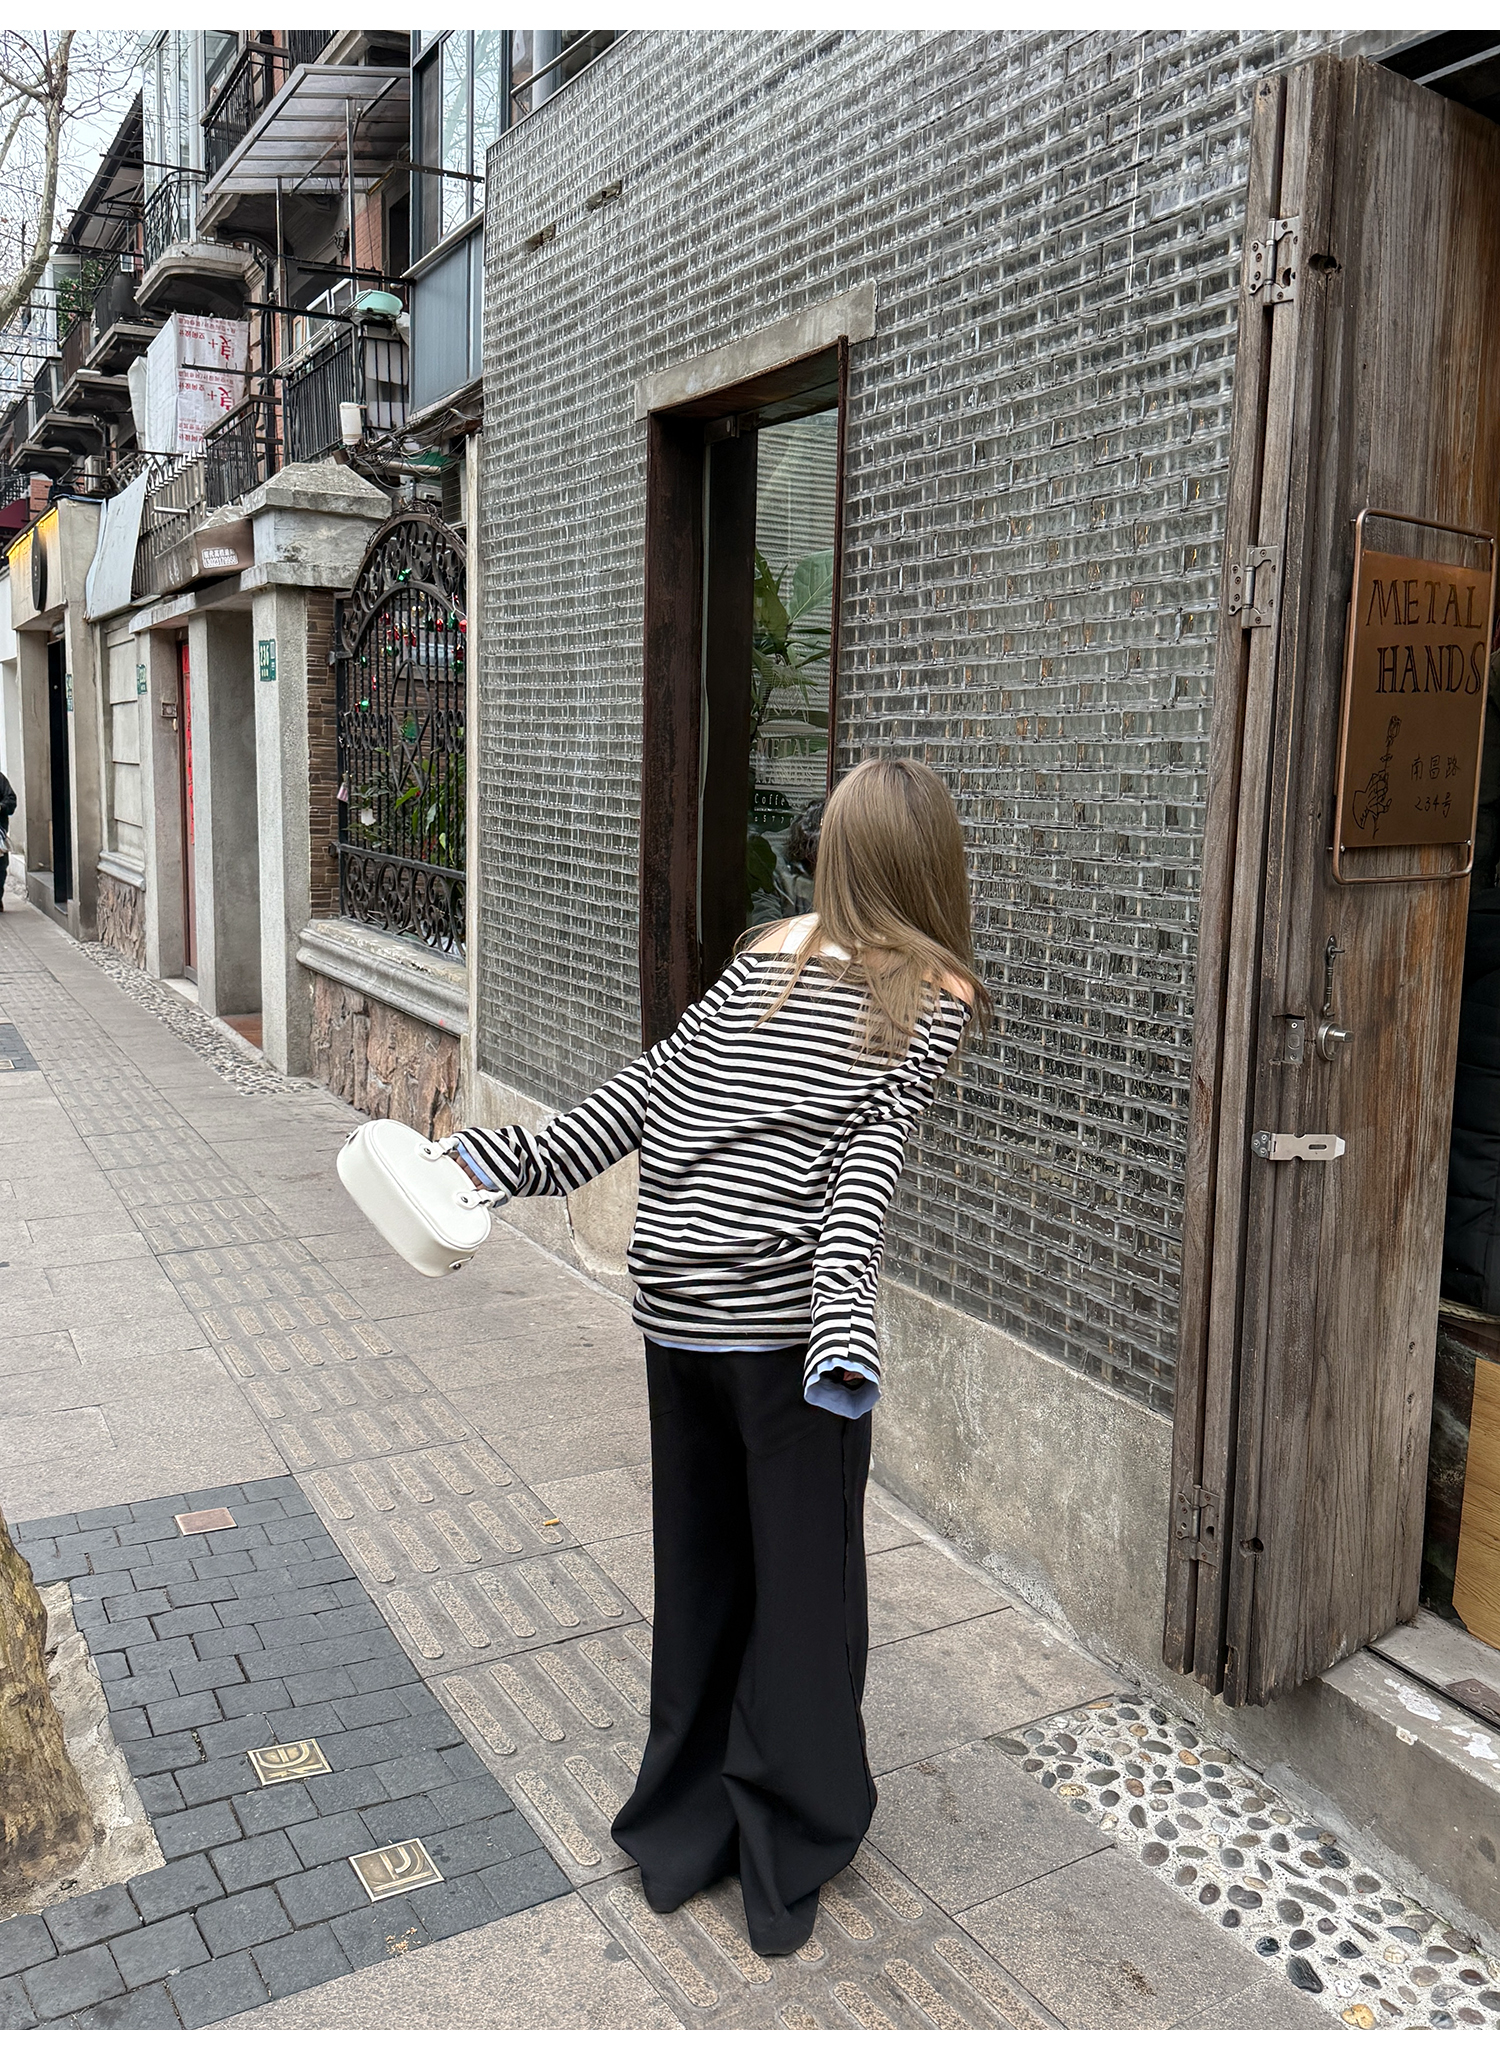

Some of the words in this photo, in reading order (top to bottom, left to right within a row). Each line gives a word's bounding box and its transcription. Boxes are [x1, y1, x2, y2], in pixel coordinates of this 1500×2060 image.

[1366, 579, 1483, 628] METAL
[1375, 641, 1485, 695] HANDS
[1410, 753, 1462, 782] 南昌路
[1414, 791, 1454, 819] 234号
